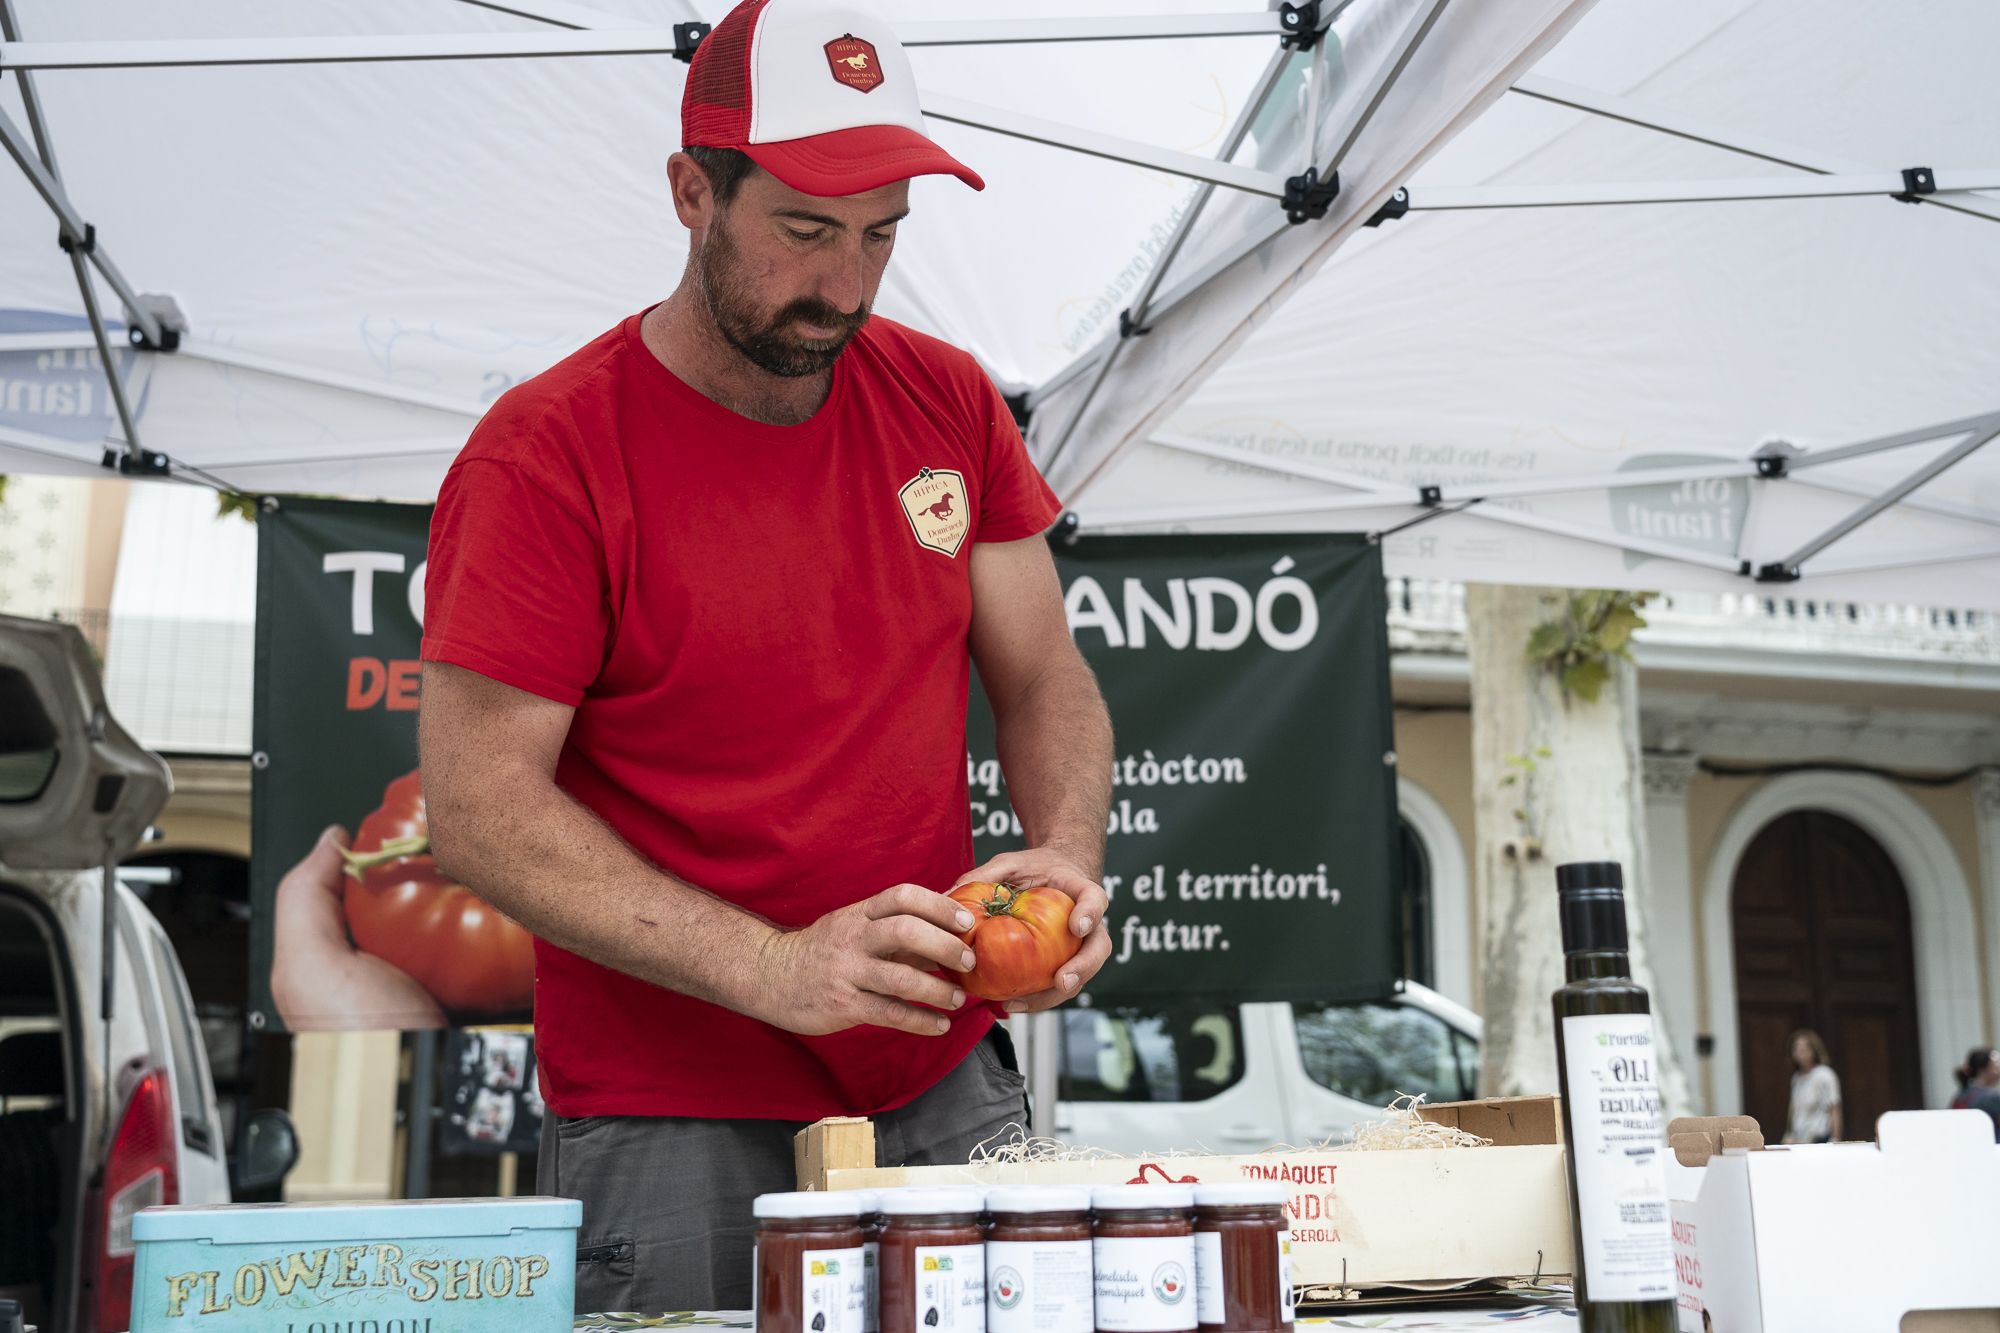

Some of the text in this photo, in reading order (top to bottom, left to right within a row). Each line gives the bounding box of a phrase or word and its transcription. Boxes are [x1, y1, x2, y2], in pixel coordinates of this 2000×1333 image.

[1064, 555, 1319, 652] ANDÓ
[1132, 864, 1167, 901] el
[1177, 863, 1341, 905] territori,
[1116, 915, 1231, 963] futur.
[1240, 1161, 1338, 1185] TOMÀQUET
[1291, 1229, 1341, 1242] SEROLA
